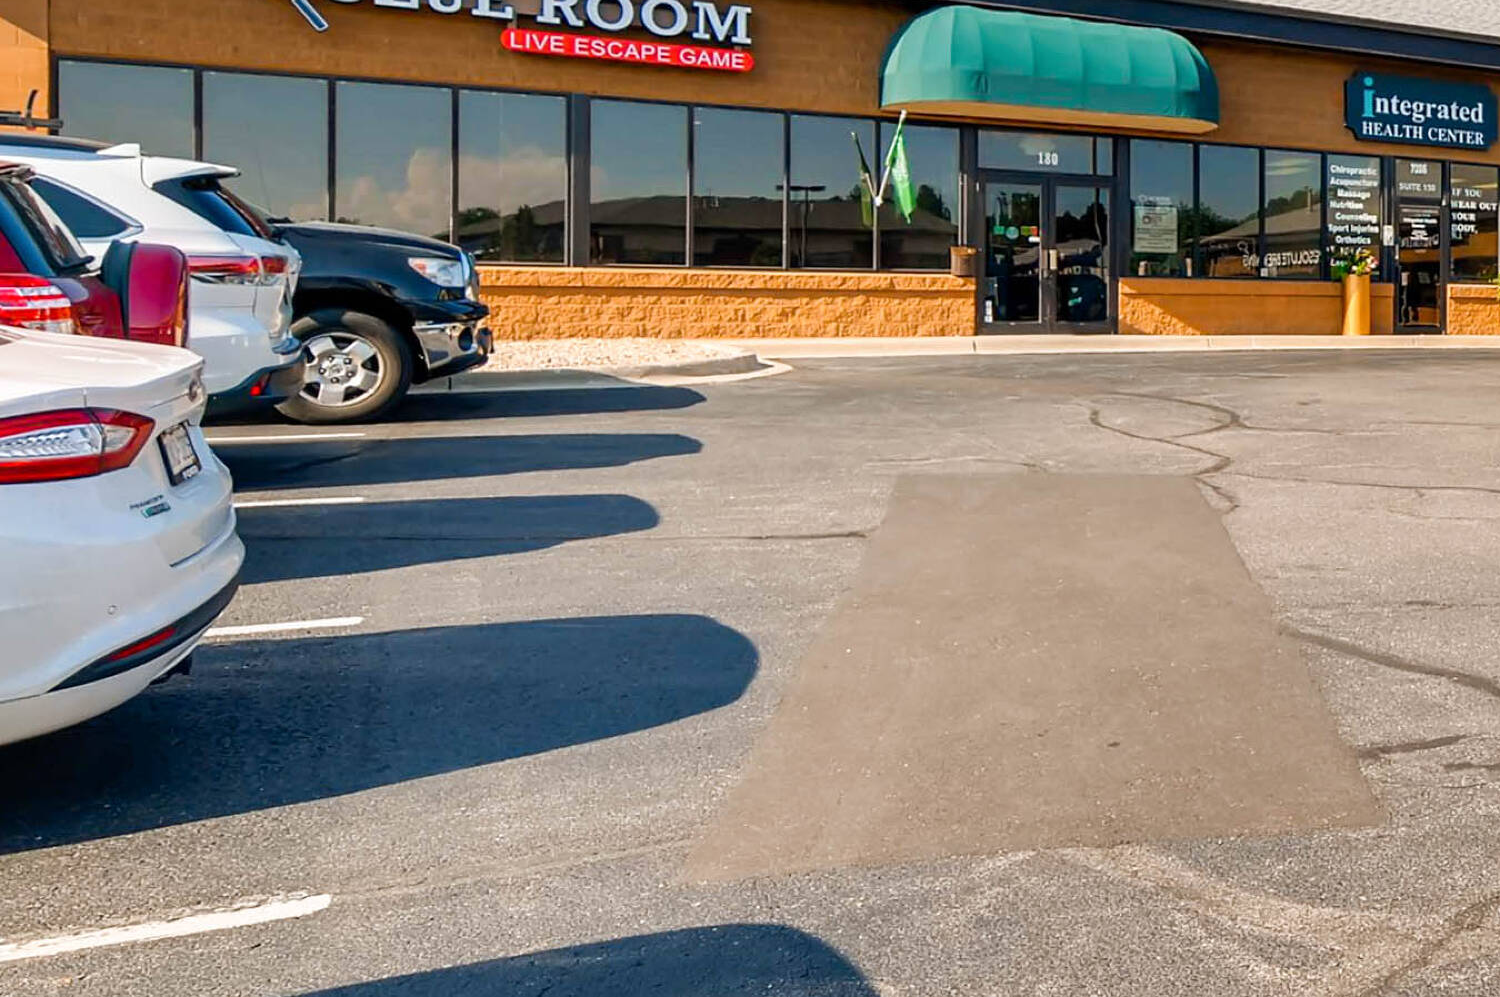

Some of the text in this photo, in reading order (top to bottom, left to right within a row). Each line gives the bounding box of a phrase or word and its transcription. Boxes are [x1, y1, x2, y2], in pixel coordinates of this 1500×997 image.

[509, 32, 745, 69] LIVE ESCAPE GAME
[1362, 76, 1484, 123] integrated
[1362, 121, 1484, 145] HEALTH CENTER
[1038, 151, 1059, 166] 180
[1329, 164, 1378, 176] Chiropractic
[1329, 177, 1378, 187] Acupuncture
[1399, 182, 1421, 191] SUITE
[1336, 188, 1372, 200] Massage
[1451, 188, 1482, 198] IF YOU
[1329, 200, 1364, 210] Nutrition
[1450, 200, 1498, 211] WEAR OUT
[1335, 212, 1378, 224] Counseling
[1451, 212, 1476, 222] YOUR
[1328, 224, 1380, 234] Sport Injuries
[1335, 235, 1372, 245] Orthotics
